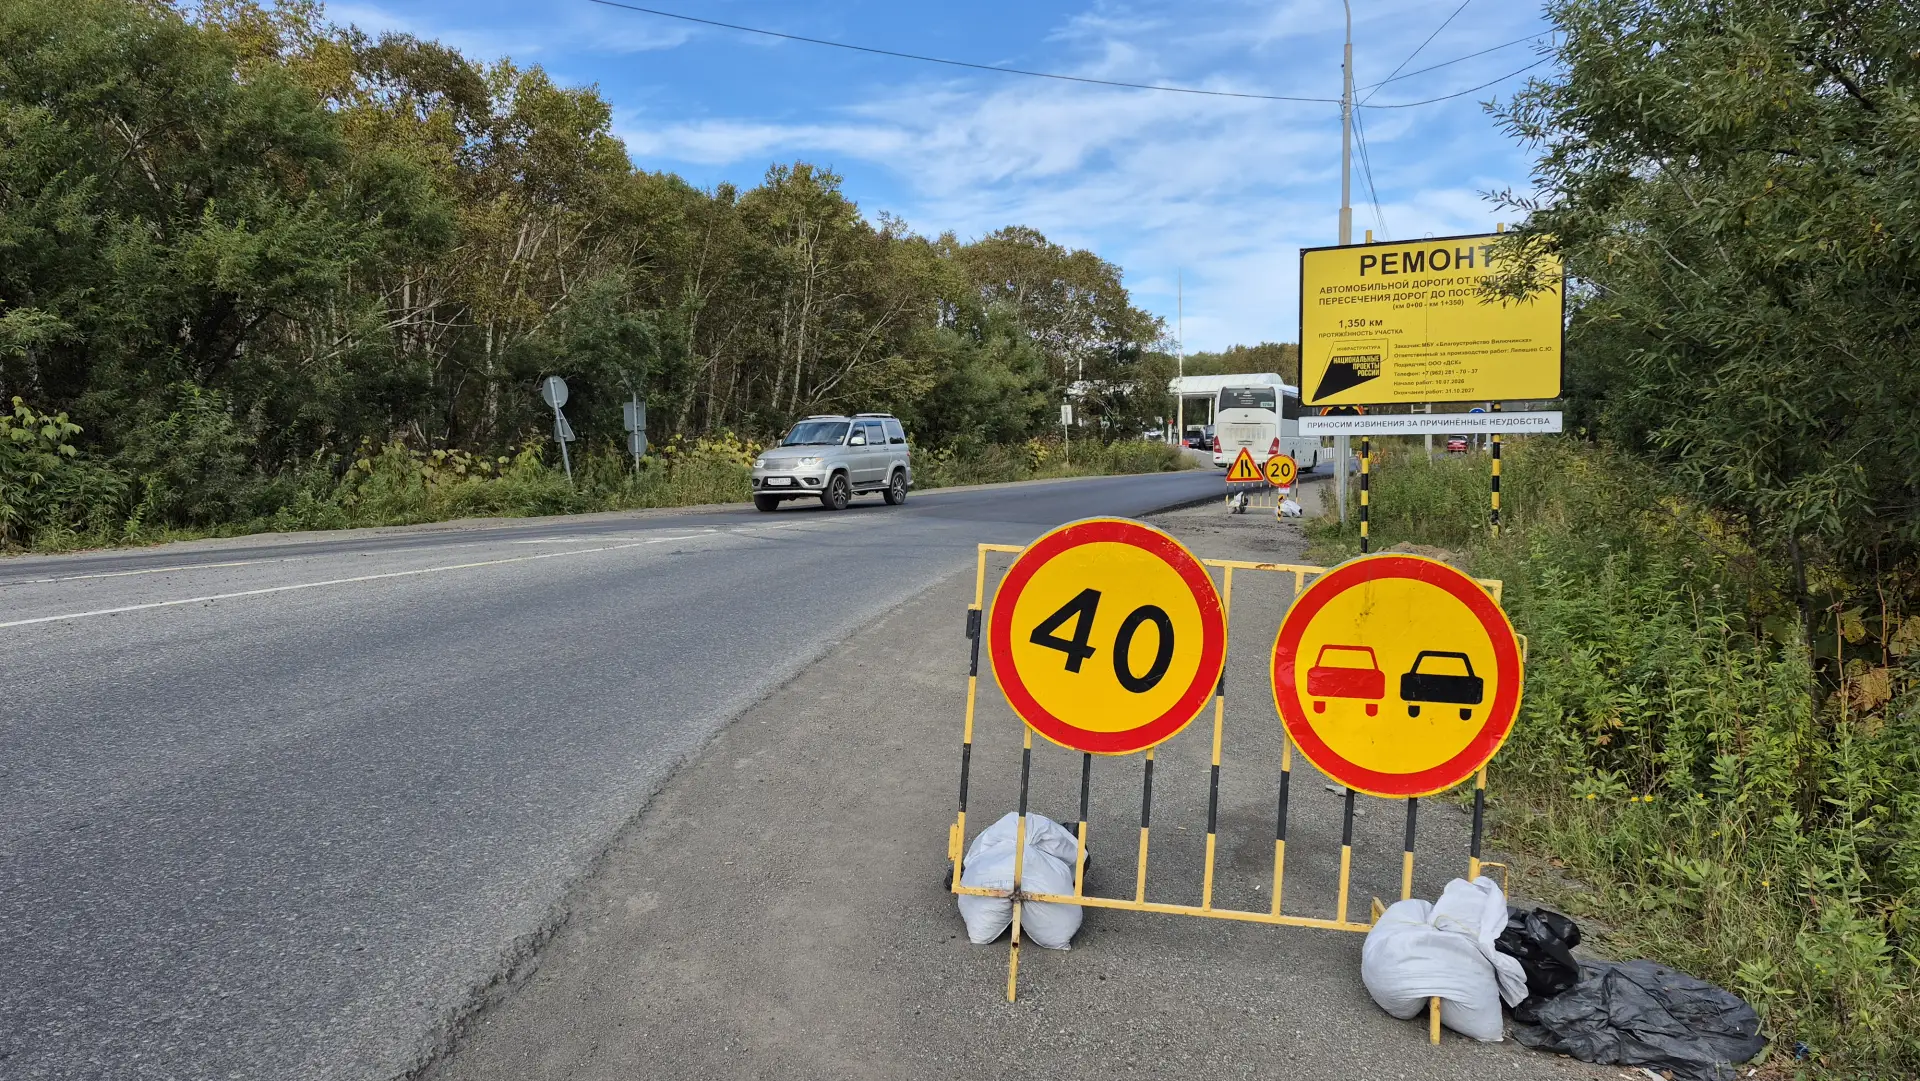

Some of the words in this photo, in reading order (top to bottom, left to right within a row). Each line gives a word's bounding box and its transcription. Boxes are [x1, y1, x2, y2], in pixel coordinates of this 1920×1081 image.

[1359, 246, 1496, 277] РЕМОНТ
[1319, 279, 1409, 294] АВТОМОБИЛЬНОЙ
[1412, 276, 1454, 288] ДОРОГИ
[1457, 276, 1472, 285] ОТ
[1318, 293, 1391, 305] ПЕРЕСЕЧЕНИЯ
[1392, 290, 1428, 302] ДОРОГ
[1430, 289, 1446, 300] ДО
[1448, 286, 1482, 298] ПОСТА
[1406, 301, 1423, 309] 0+00
[1440, 298, 1464, 307] 1+350)
[1338, 318, 1366, 329] 1,350
[1374, 328, 1404, 336] УЧАСТКА
[1333, 355, 1380, 364] НАЦИОНАЛЬНЫЕ
[1352, 362, 1380, 370] ПРОЕКТЫ
[1357, 369, 1380, 377] РОССИИ
[1307, 421, 1353, 429] ПРИНОСИМ
[1354, 420, 1405, 428] ИЗВИНЕНИЯ
[1406, 419, 1418, 427] ЗА
[1420, 417, 1487, 427] ПРИЧИНЁННЫЕ
[1489, 417, 1551, 426] НЕУДОБСТВА
[1270, 463, 1291, 478] 20
[1029, 588, 1175, 693] 40
